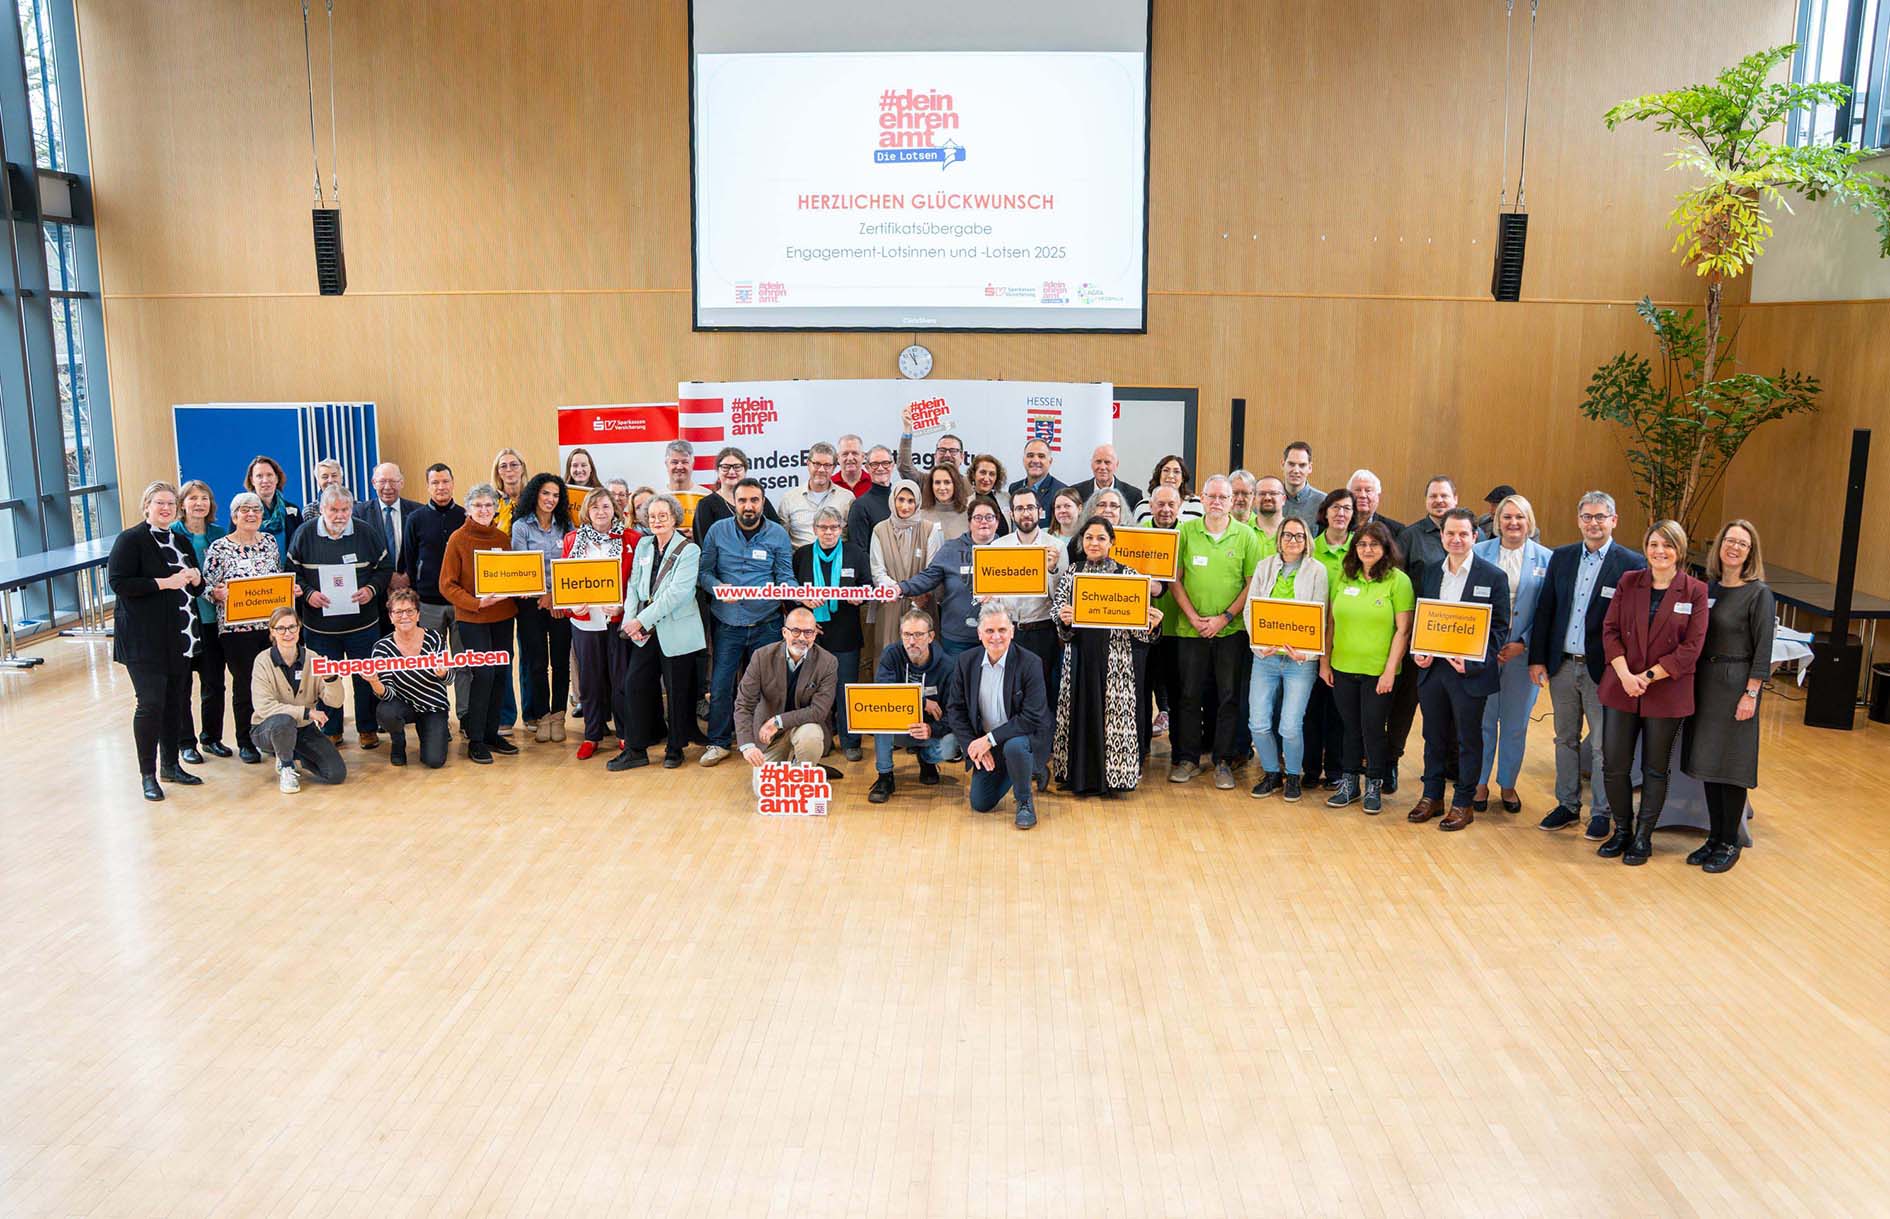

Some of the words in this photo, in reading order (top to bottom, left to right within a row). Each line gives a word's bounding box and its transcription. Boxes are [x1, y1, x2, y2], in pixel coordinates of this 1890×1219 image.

[880, 89, 953, 111] #dein
[879, 111, 959, 129] ehren
[879, 130, 935, 147] amt
[877, 152, 896, 161] Die
[900, 152, 938, 161] Lotsen
[798, 194, 905, 209] HERZLICHEN
[911, 191, 1054, 209] GLÜCKWUNSCH
[859, 222, 992, 237] Zertifikatsübergabe
[786, 245, 946, 261] Engagement-Lotsinnen
[950, 246, 977, 259] und
[981, 246, 1031, 259] -Lotsen
[1034, 247, 1067, 259] 2025
[731, 397, 774, 412] #dein
[911, 397, 945, 412] #dein
[1027, 397, 1063, 407] HESSEN
[731, 410, 778, 424] ehren
[911, 406, 950, 421] ehren
[731, 423, 764, 435] amt
[913, 418, 940, 430] amt
[1115, 546, 1170, 560] Hünstetten
[483, 569, 498, 578] Bad
[499, 568, 537, 579] Homburg
[981, 566, 1039, 577] Wiesbaden
[561, 576, 615, 590] Herborn
[245, 587, 273, 597] Höchst
[715, 584, 894, 599] www.deinehrenamt.de
[1081, 591, 1141, 603] Schwalbach
[233, 600, 244, 608] im
[245, 596, 287, 607] Odenwald
[1103, 607, 1131, 616] Taunus
[1428, 610, 1477, 623] Marktgemeinde
[1258, 618, 1316, 636] Battenberg
[1426, 619, 1475, 636] Eiterfeld
[312, 650, 509, 676] Engagement-Lotsen
[854, 702, 915, 715] Ortenberg
[760, 764, 825, 783] #dein
[760, 781, 830, 798] ehren
[760, 797, 809, 814] amt
